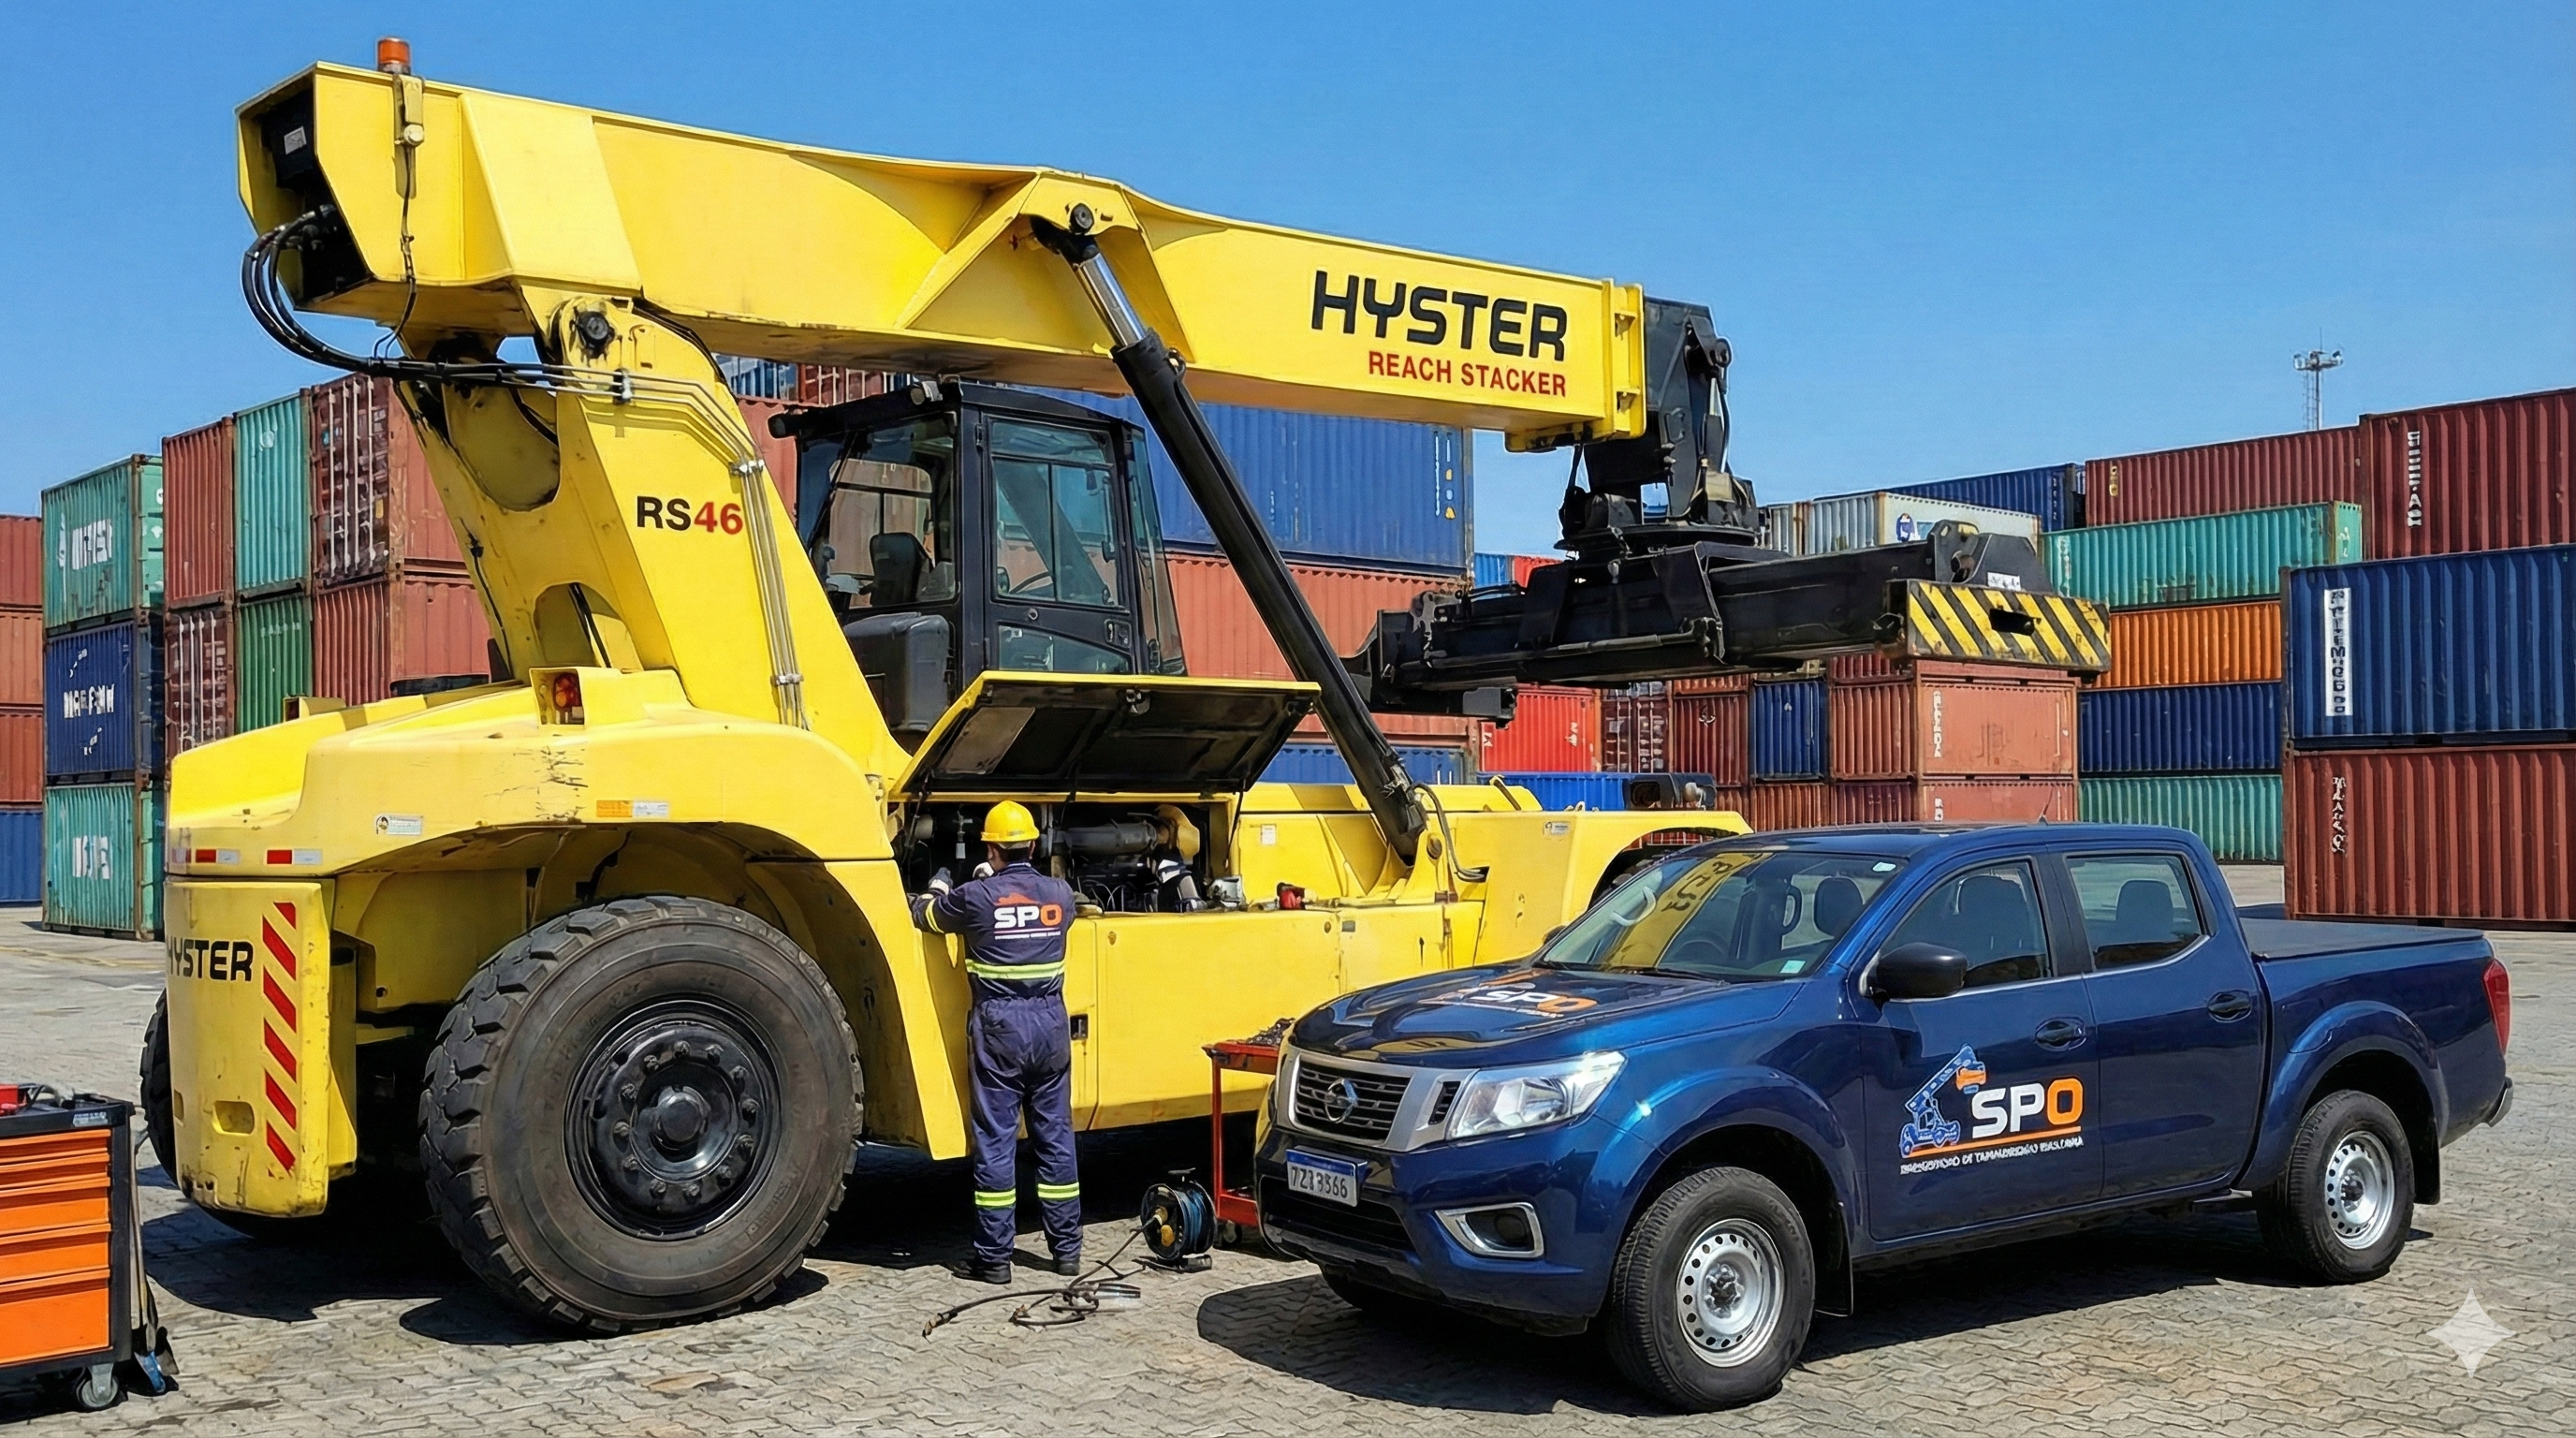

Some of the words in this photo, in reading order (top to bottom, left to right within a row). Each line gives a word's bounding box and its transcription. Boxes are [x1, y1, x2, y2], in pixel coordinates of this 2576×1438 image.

[1311, 270, 1567, 362] HYSTER
[1368, 351, 1452, 384] REACH
[1461, 362, 1566, 397] STACKER
[637, 495, 743, 536] RS46
[993, 903, 1062, 929] SPO
[1470, 990, 1599, 1014] SPO
[1971, 1077, 2084, 1139] SPO
